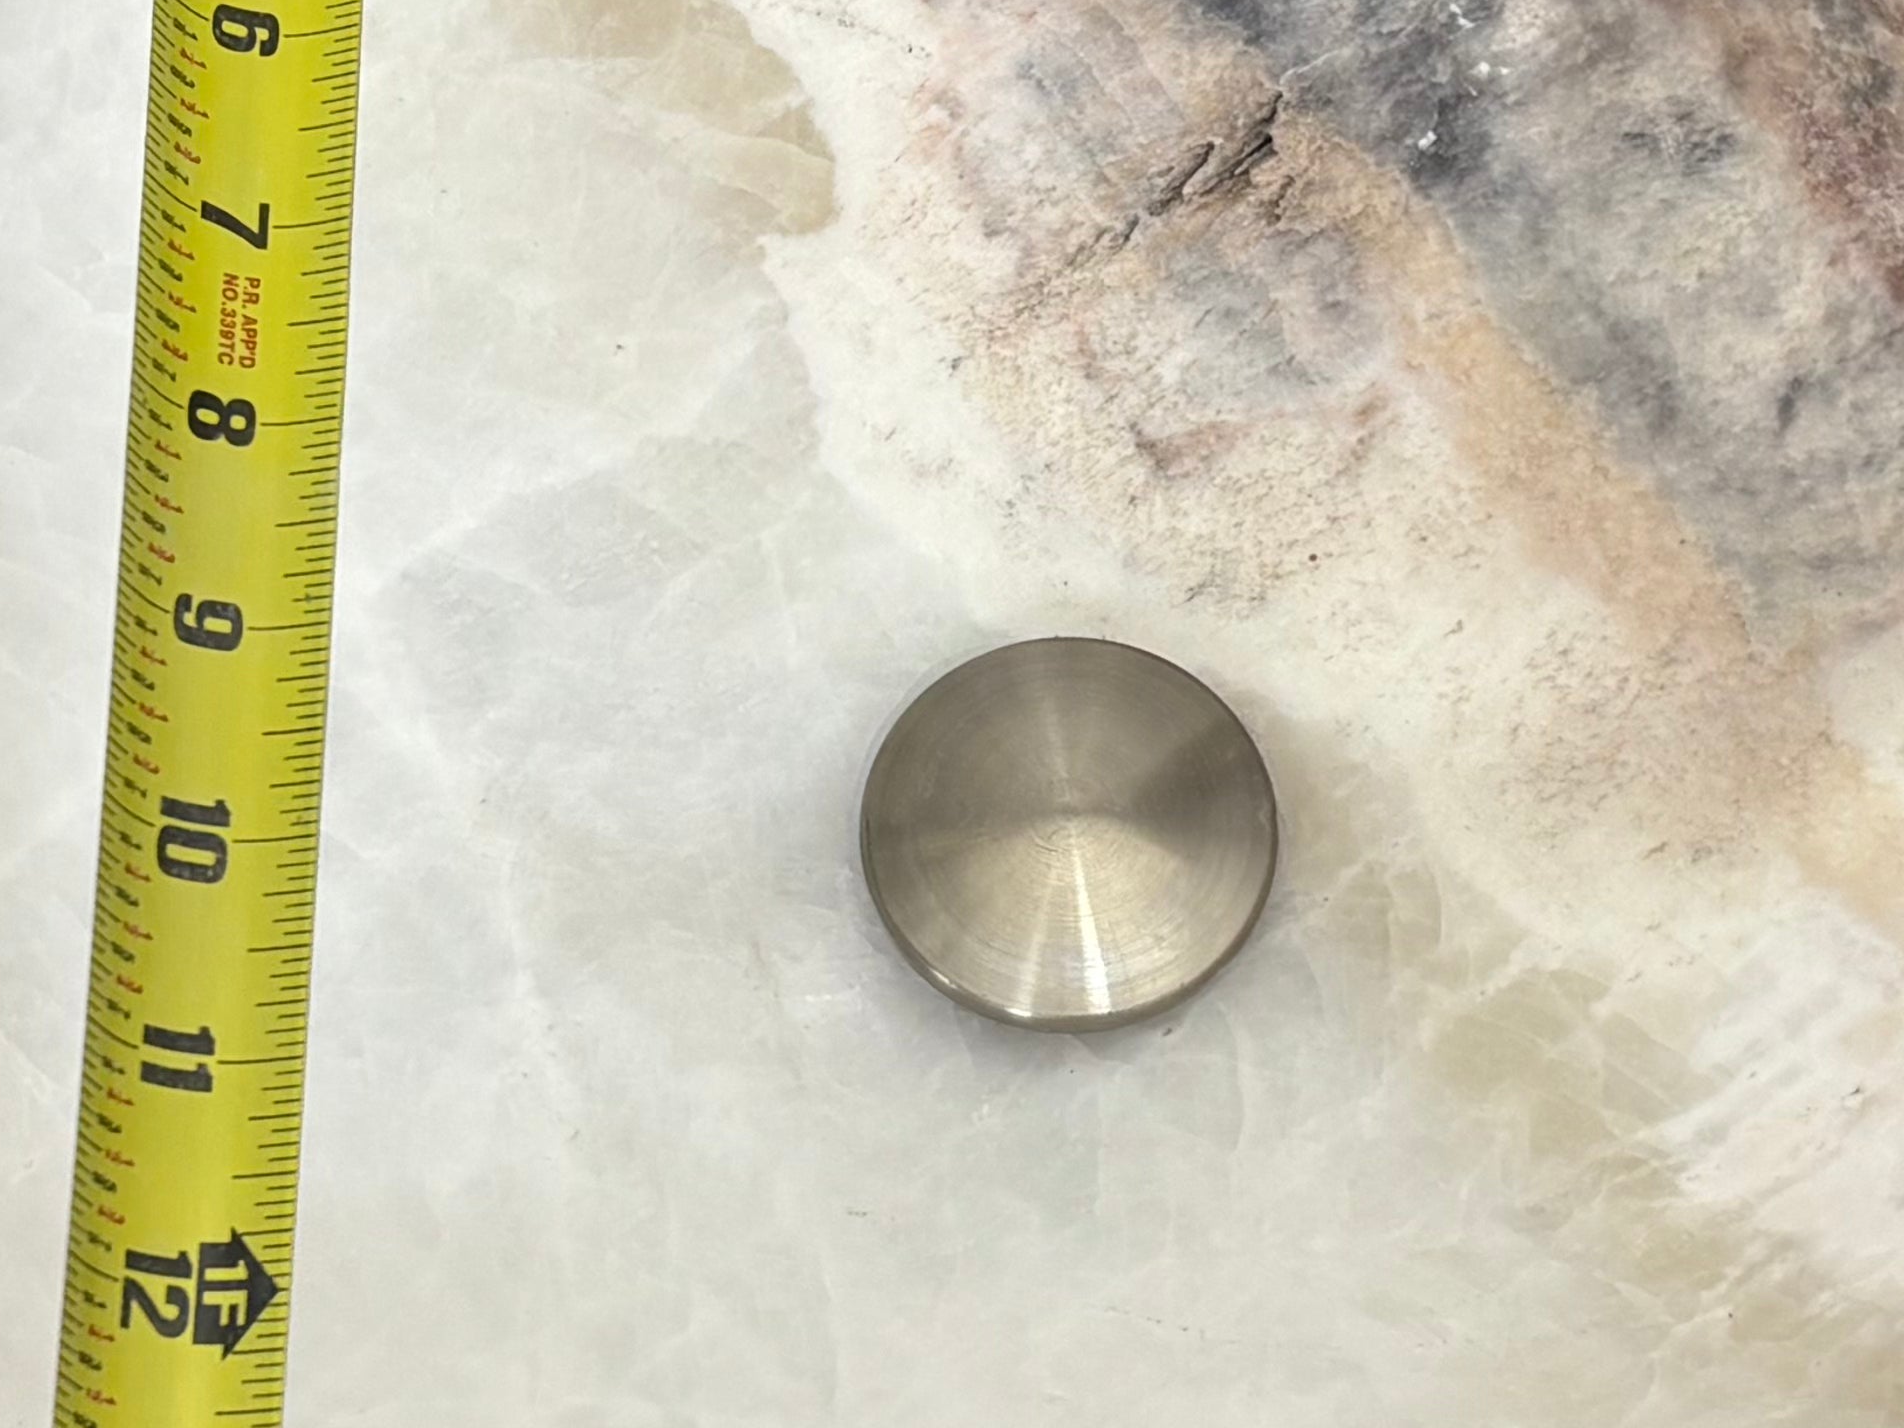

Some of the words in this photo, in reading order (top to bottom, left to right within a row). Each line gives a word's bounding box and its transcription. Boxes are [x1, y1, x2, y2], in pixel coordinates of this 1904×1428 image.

[212, 4, 280, 57] 6
[200, 199, 269, 250] 7
[187, 389, 256, 447] 8
[173, 593, 243, 652] 9
[157, 795, 232, 884] 10
[140, 1024, 216, 1093] 11
[120, 1249, 192, 1339] 12
[202, 1260, 248, 1326] 1F
